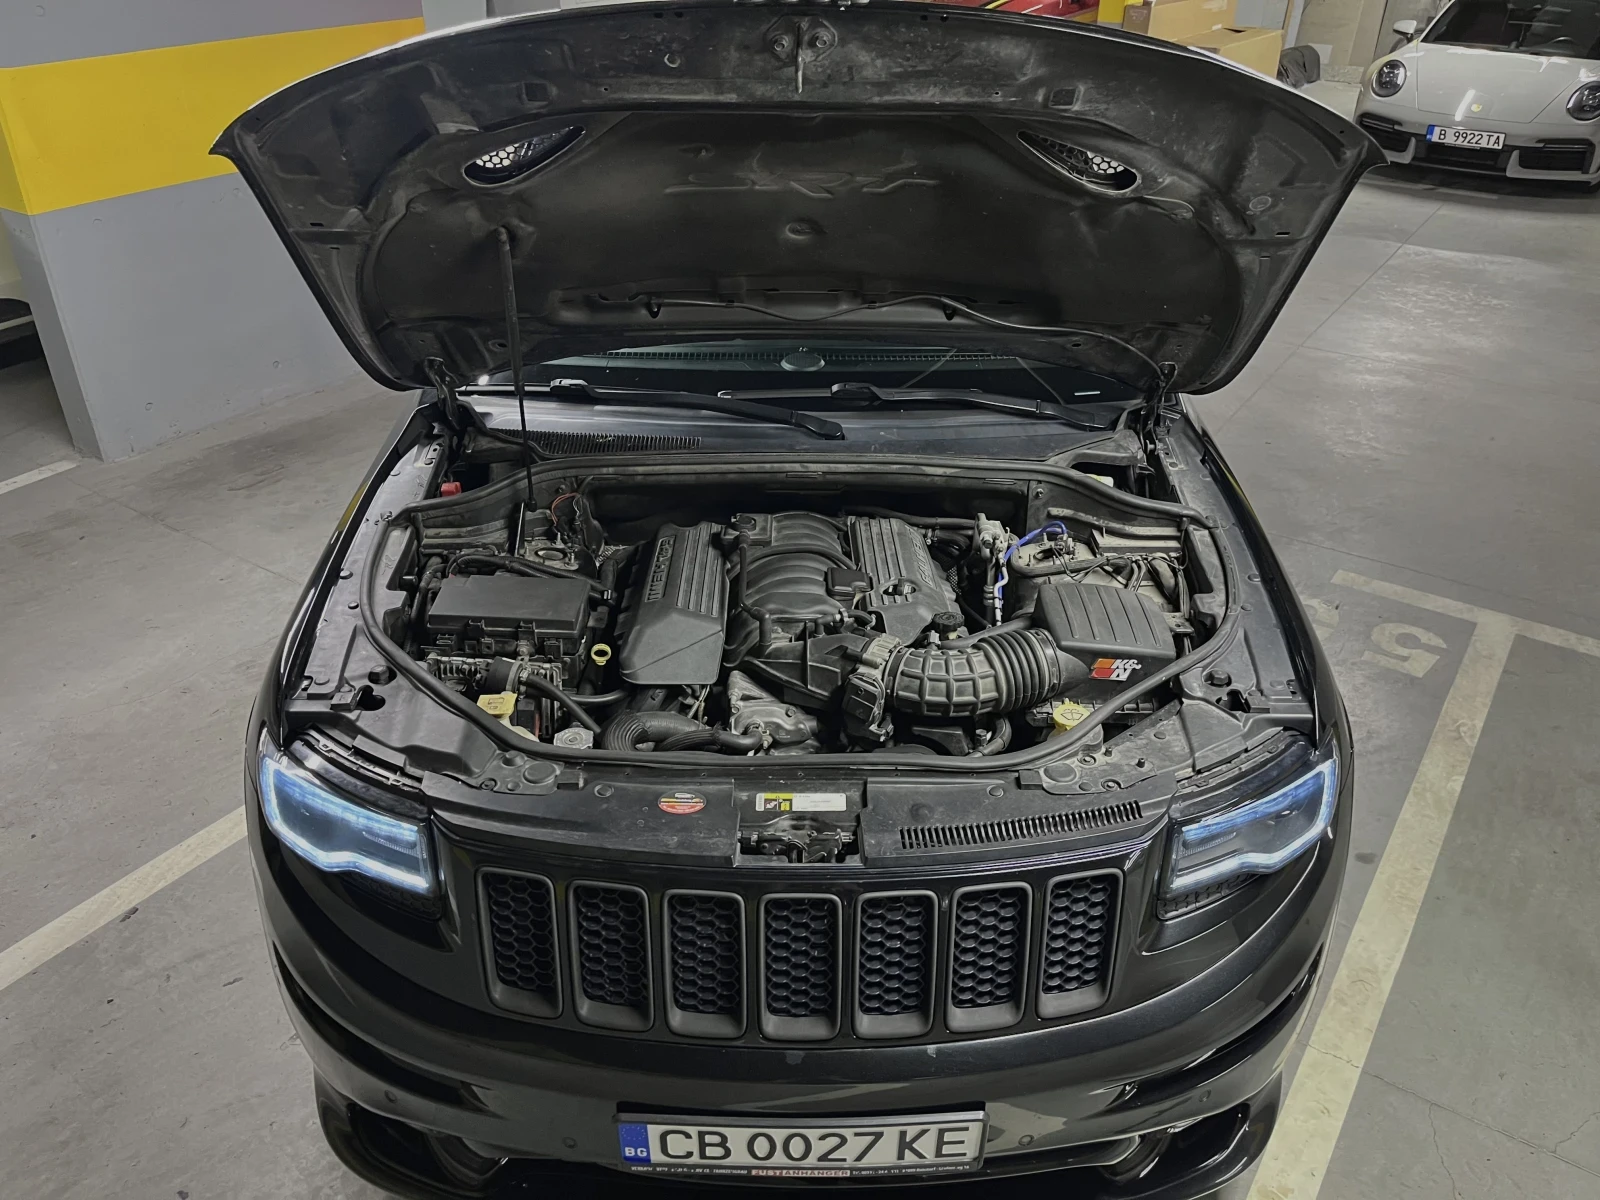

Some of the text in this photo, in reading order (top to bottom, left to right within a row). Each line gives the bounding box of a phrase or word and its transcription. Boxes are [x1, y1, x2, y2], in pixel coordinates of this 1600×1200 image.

[1438, 129, 1447, 141] B
[1453, 131, 1484, 145] 9922
[1486, 134, 1500, 147] TA
[624, 1147, 648, 1157] BG
[659, 1126, 970, 1163] CB 0027 KE
